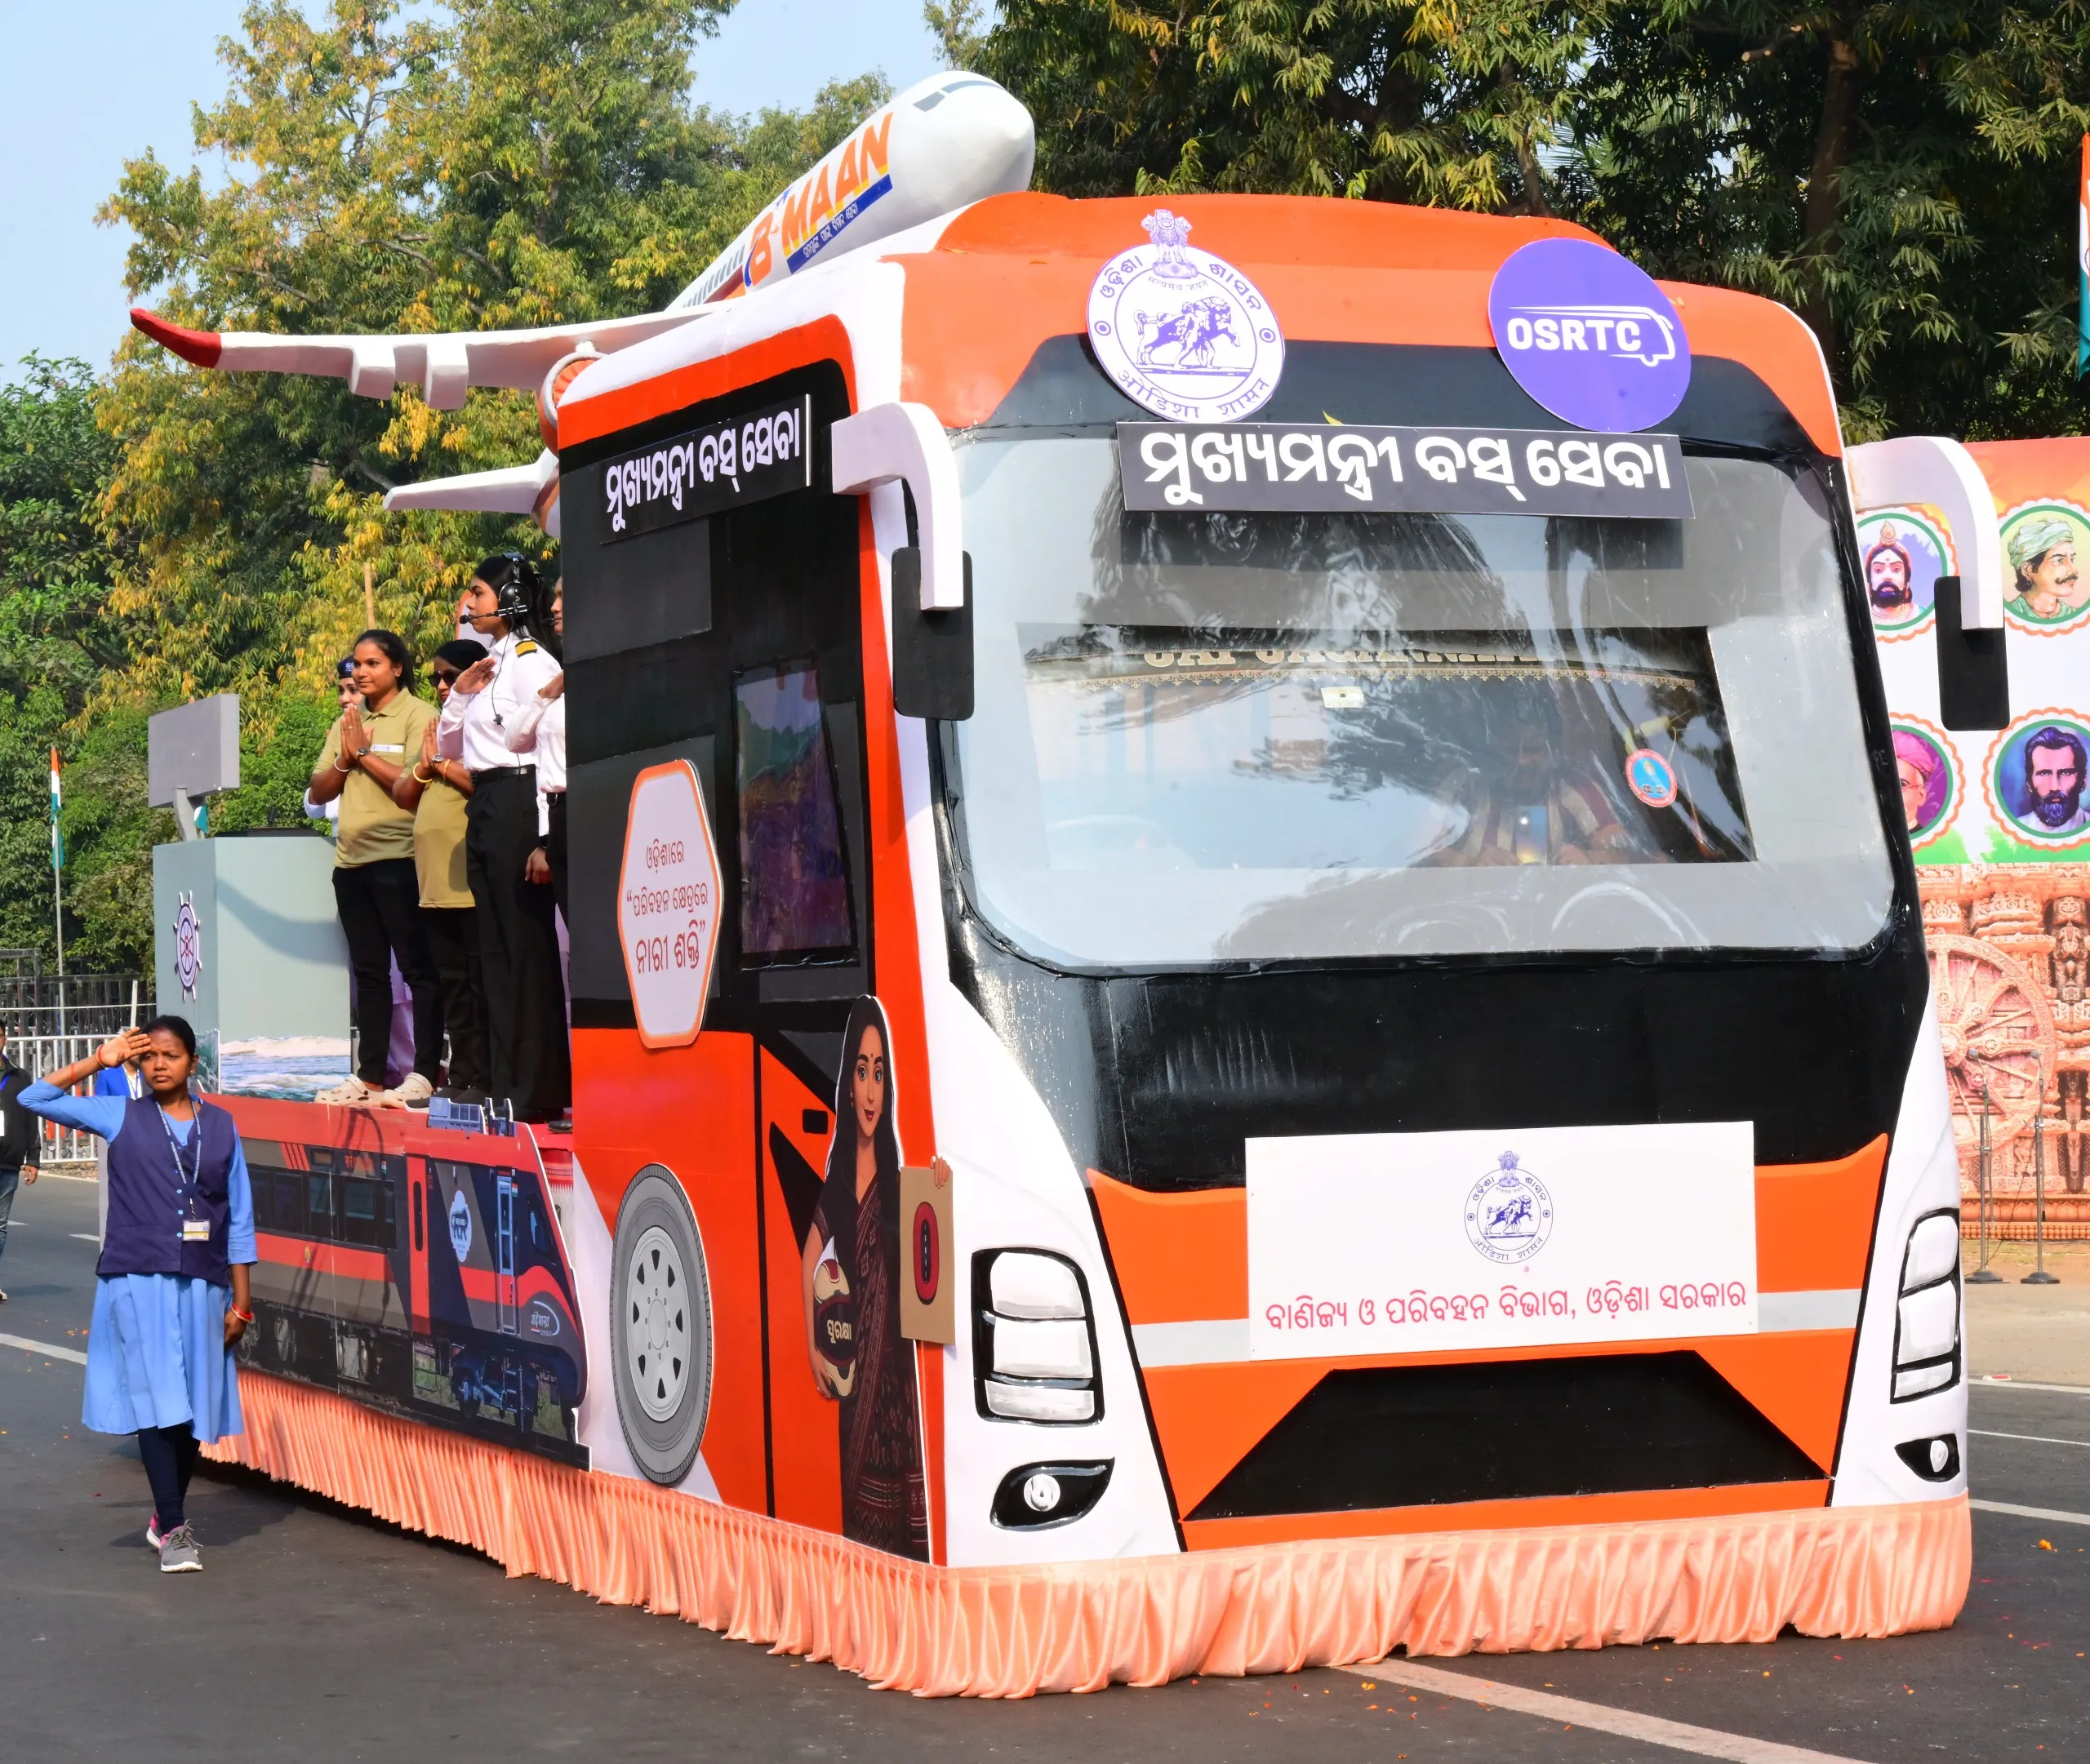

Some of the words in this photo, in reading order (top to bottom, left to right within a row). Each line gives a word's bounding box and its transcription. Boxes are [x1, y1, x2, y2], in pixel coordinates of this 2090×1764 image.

[747, 111, 893, 286] B-MAAN
[1209, 263, 1261, 310] ଶାସନ
[1507, 318, 1642, 351] OSRTC
[1216, 377, 1270, 417] शासन
[606, 442, 694, 532] ମୁଖ୍ୟମନ୍ତ୍ରୀ
[699, 428, 740, 493] ବସ୍
[741, 408, 800, 473] ସେବା
[1141, 432, 1403, 505] ମୁଖ୍ୟମନ୍ତ୍ରୀ
[1415, 436, 1527, 501] ବସ୍
[1526, 439, 1670, 489] ସେବା
[646, 838, 684, 873] ଓଡ଼ିଶାରେ
[673, 882, 708, 913] କ୍ଷେତ୍ରରେ
[636, 935, 669, 974] ନାରୀ
[1265, 1295, 1347, 1329] ବାଣିଜ୍ୟ
[1358, 1298, 1376, 1326] ଓ
[1385, 1290, 1489, 1324] ପରିବହନ
[1499, 1285, 1576, 1319] ବିଭାଗ,
[1587, 1280, 1649, 1319] ଓଡ଼ିଶା
[1660, 1282, 1745, 1309] ସରକାର
